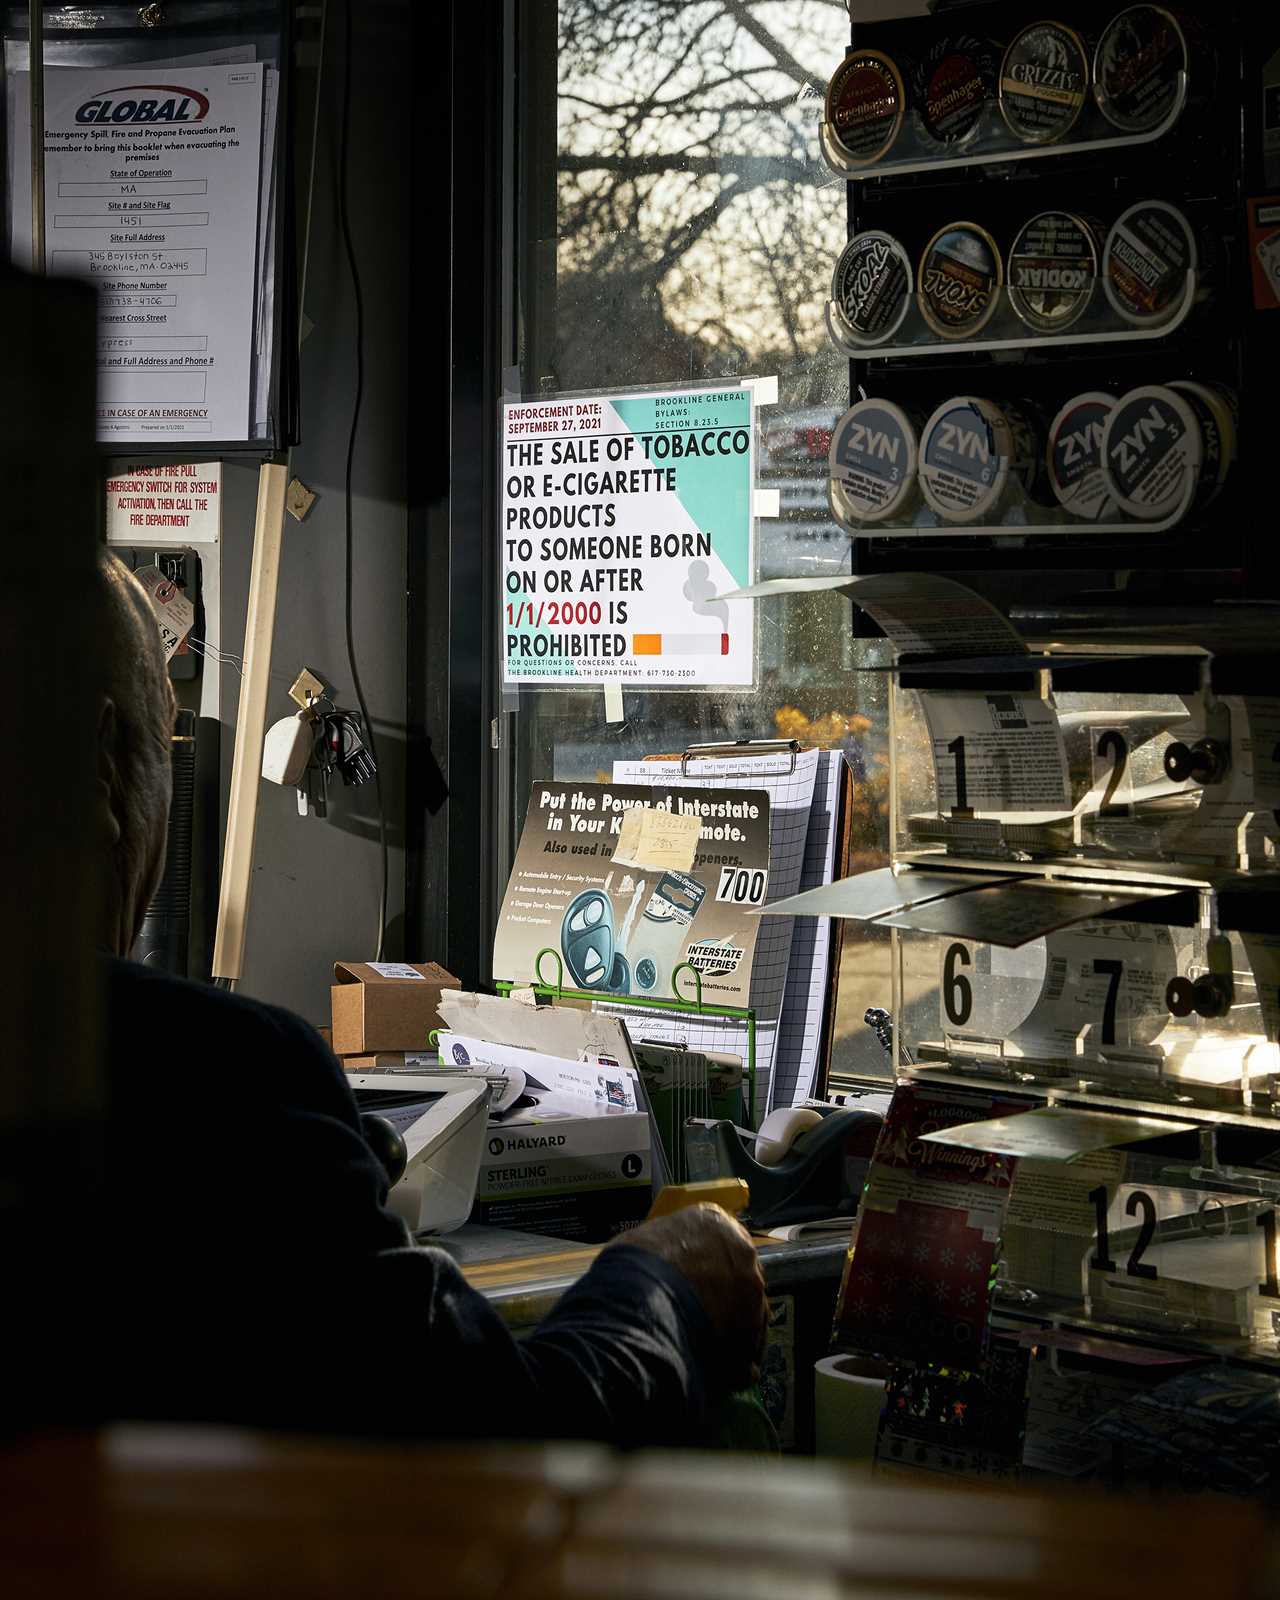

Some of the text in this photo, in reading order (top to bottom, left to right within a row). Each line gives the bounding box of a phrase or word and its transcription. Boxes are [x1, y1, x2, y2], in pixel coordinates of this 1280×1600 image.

[75, 98, 191, 123] GLOBAL
[835, 96, 896, 126] Copenhagen
[45, 125, 236, 140] Emergency Fire and Propane Evacuation Plan
[42, 138, 240, 153] emember to bring this booklet when evacuating the
[125, 152, 160, 163] premises
[110, 168, 172, 178] State of Operation
[120, 184, 137, 194] MA
[108, 201, 121, 210] Site
[128, 201, 142, 209] and
[143, 200, 156, 209] Site
[157, 200, 171, 210] Flag
[120, 216, 142, 226] 1451
[110, 232, 166, 241] Site Full Address
[88, 252, 105, 261] 345
[106, 251, 149, 263] Boylston
[160, 262, 189, 270] 02445
[103, 281, 168, 290] Site Phone Number
[846, 241, 890, 322] SKOAL
[1018, 268, 1088, 289] KODIAK
[925, 268, 992, 315] SKOAL
[102, 314, 125, 322] earest
[146, 313, 167, 321] Street
[108, 357, 122, 365] and
[123, 357, 137, 365] Full
[138, 356, 168, 365] Address
[169, 356, 183, 365] and
[184, 356, 208, 364] Phone
[655, 392, 745, 407] BROOKLINE GENERAL
[107, 409, 116, 417] IN
[117, 409, 136, 417] CASE
[137, 409, 148, 417] OF
[149, 409, 161, 417] AN
[162, 409, 208, 418] EMERGENCY
[508, 402, 602, 420] ENFORCEMENT DATE:
[655, 408, 690, 418] BYLAWS:
[508, 417, 601, 434] SEPTEMBER 27, 2021
[655, 417, 719, 429] SECTION 8.23.5
[1167, 423, 1179, 440] 3
[847, 422, 899, 464] ZYN
[937, 421, 988, 464] ZYN
[1057, 414, 1104, 466] ZYN
[1110, 404, 1167, 475] ZYN
[507, 430, 750, 466] THE SALE OF TOBACCO
[127, 464, 198, 477] IN CASE OF FIRE PULL
[889, 467, 898, 481] 3
[980, 467, 990, 482] 6
[106, 480, 218, 494] EMERGENCY SWITCH FOR SYSTEM
[506, 467, 676, 498] OR E-CIGARETTE
[118, 498, 208, 511] ACTIVATION, THEN CALL THE
[130, 514, 190, 527] FIRE DEPARTMENT
[506, 503, 616, 530] PRODUCTS
[506, 532, 711, 562] TO SOMEONE BORN
[506, 568, 644, 593] ON OR AFTER
[506, 601, 628, 628] 1/1/2000 IS
[507, 633, 626, 657] PROHIBITED
[507, 659, 521, 667] FOR
[523, 659, 562, 667] QUESTIONS
[507, 669, 521, 677] THE
[523, 669, 564, 677] BROOKLINE
[565, 669, 592, 677] HEALTH
[948, 736, 974, 818] 1
[1097, 731, 1130, 817] 2
[539, 791, 760, 820] Put the Power of Interstate
[546, 812, 563, 832] in
[569, 814, 606, 833] Your
[699, 824, 747, 842] mote.
[543, 841, 568, 854] Also
[571, 843, 597, 856] used
[600, 844, 613, 856] in
[720, 868, 765, 903] 700
[687, 945, 743, 960] INTERSTATE
[688, 956, 737, 970] BATTERIES
[943, 942, 973, 1026] 6
[1093, 959, 1123, 1045] 7
[508, 1135, 566, 1150] HALYARD
[487, 1165, 546, 1183] STERLING
[627, 1159, 636, 1174] L
[1088, 1185, 1158, 1280] 12
